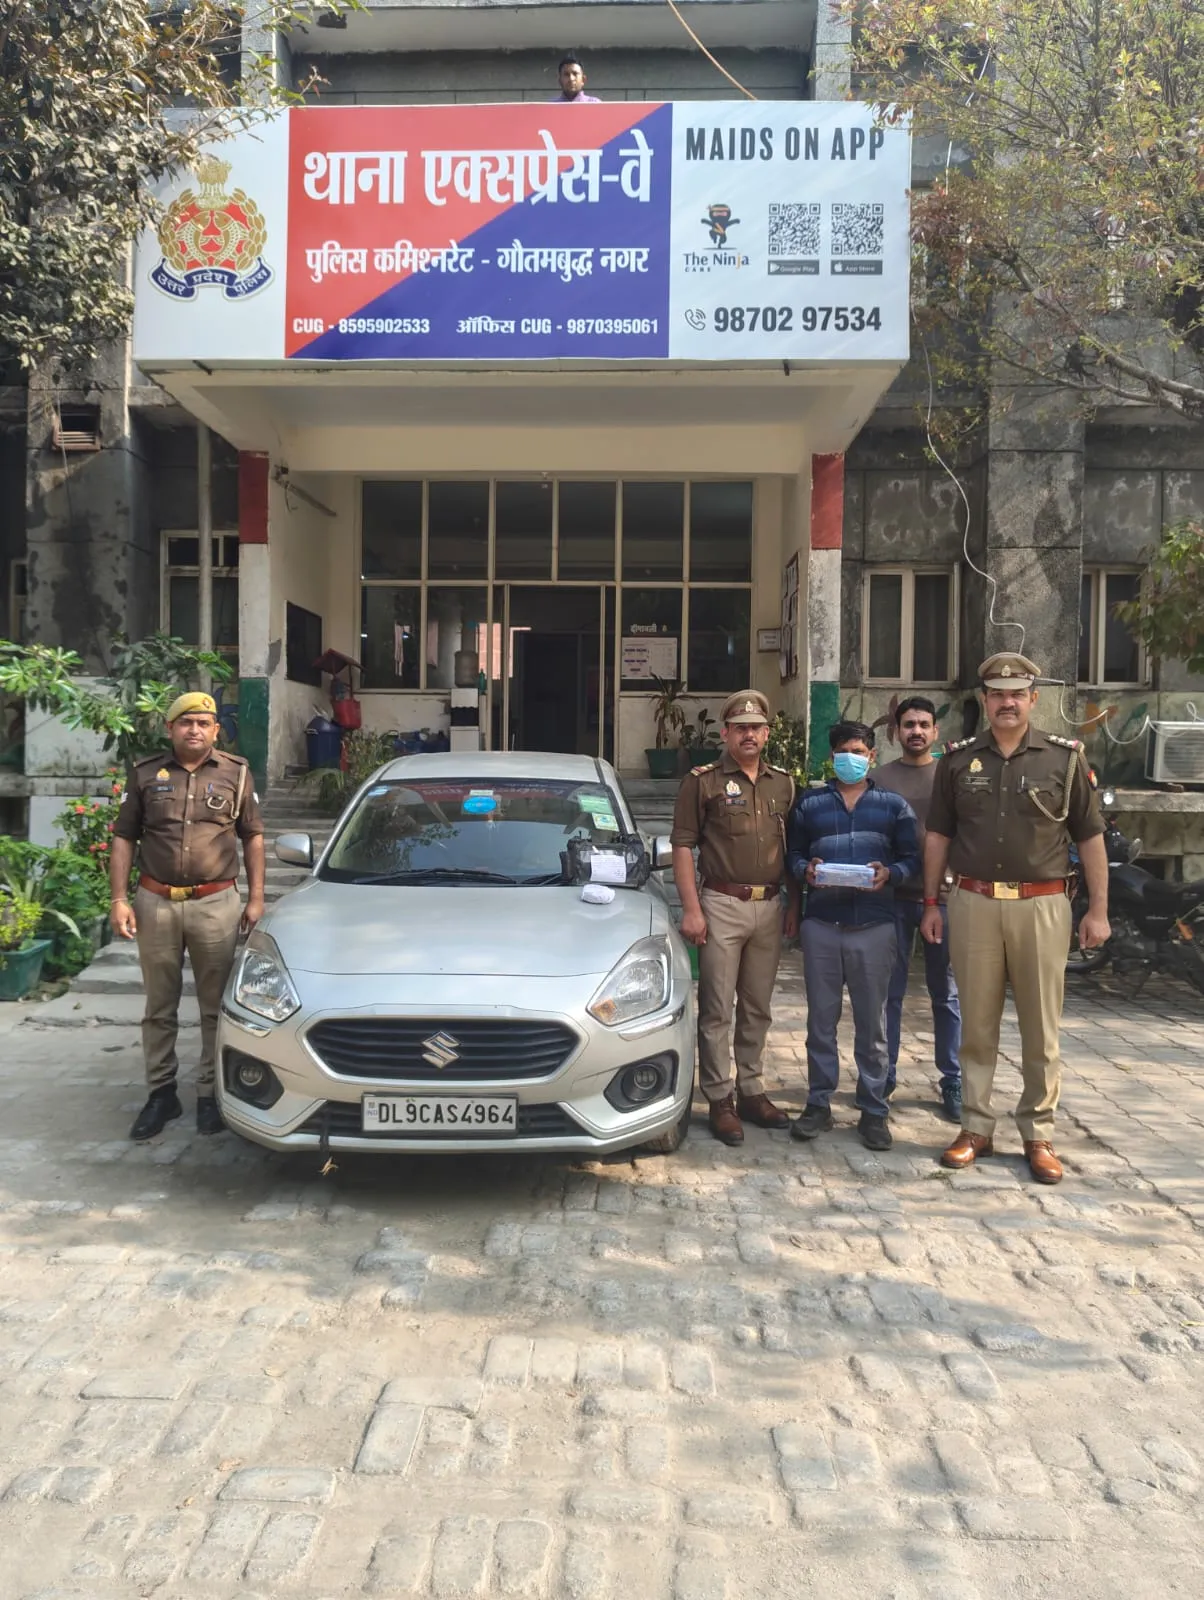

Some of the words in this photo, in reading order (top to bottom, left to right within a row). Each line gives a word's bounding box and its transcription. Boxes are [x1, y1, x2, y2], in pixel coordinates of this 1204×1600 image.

[685, 126, 774, 161] MAIDS
[784, 126, 819, 161] ON
[830, 126, 885, 161] APP
[303, 151, 408, 205] थाना
[420, 128, 655, 206] एक्सप्रेस-वे
[305, 240, 368, 283] पुलिस
[373, 239, 475, 274] कमिश्नरेट
[496, 239, 594, 282] गौतमबुद्ध
[600, 247, 650, 273] नगर
[683, 251, 709, 266] The
[713, 251, 750, 269] Ninja
[845, 265, 859, 274] App
[157, 272, 186, 295] उत्तर
[192, 269, 229, 284] प्रदेश
[293, 318, 324, 334] CUG
[338, 318, 430, 334] 8595902533
[456, 315, 516, 334] ऑफिस
[521, 318, 552, 334] CUG
[567, 318, 658, 334] 9870395061
[714, 306, 793, 332] 98702
[802, 306, 882, 332] 97534
[378, 1103, 514, 1125] DL9CAS4964
